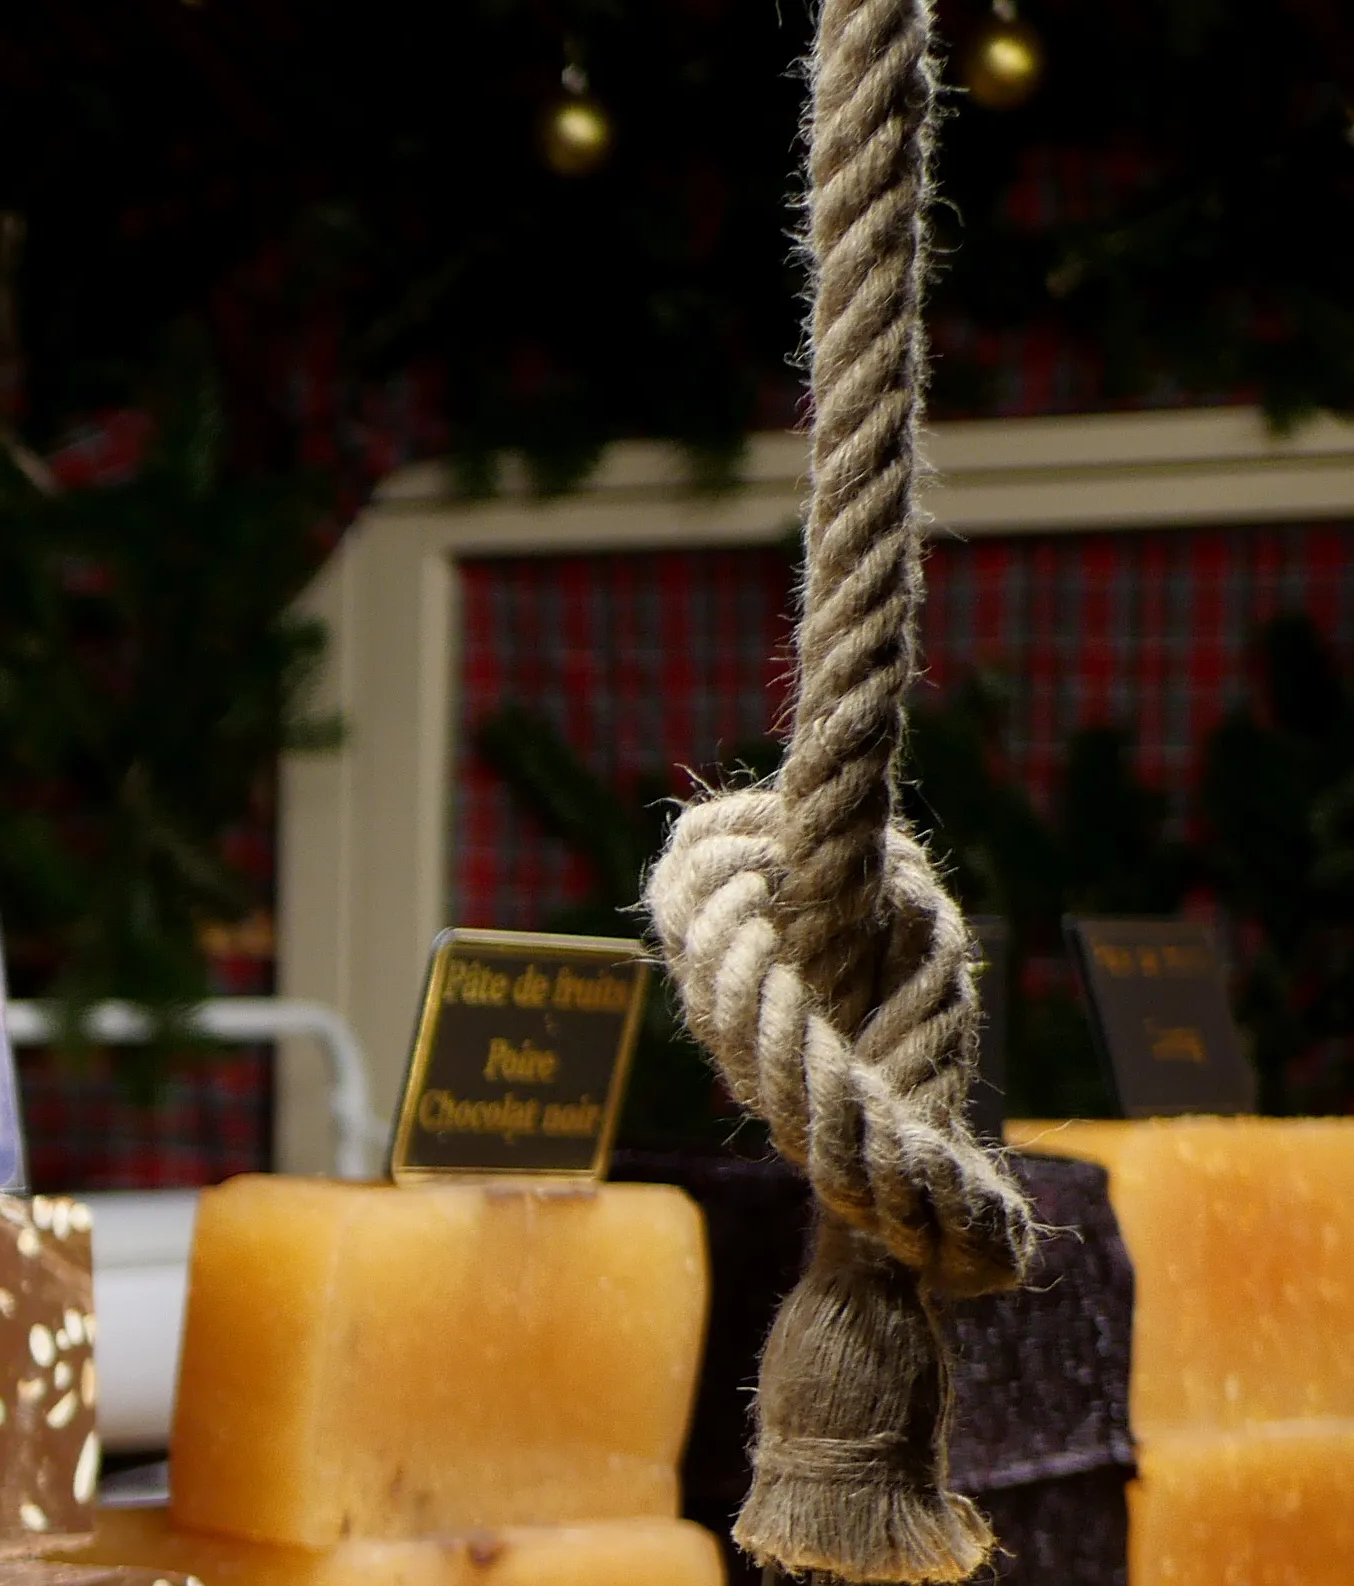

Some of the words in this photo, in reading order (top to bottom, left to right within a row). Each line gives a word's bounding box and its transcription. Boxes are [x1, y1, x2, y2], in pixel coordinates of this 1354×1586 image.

[443, 959, 510, 1006] Pâte
[512, 964, 550, 1008] de
[483, 1037, 560, 1083] Poire
[419, 1090, 538, 1134] Chocolat
[543, 1094, 601, 1136] noir
